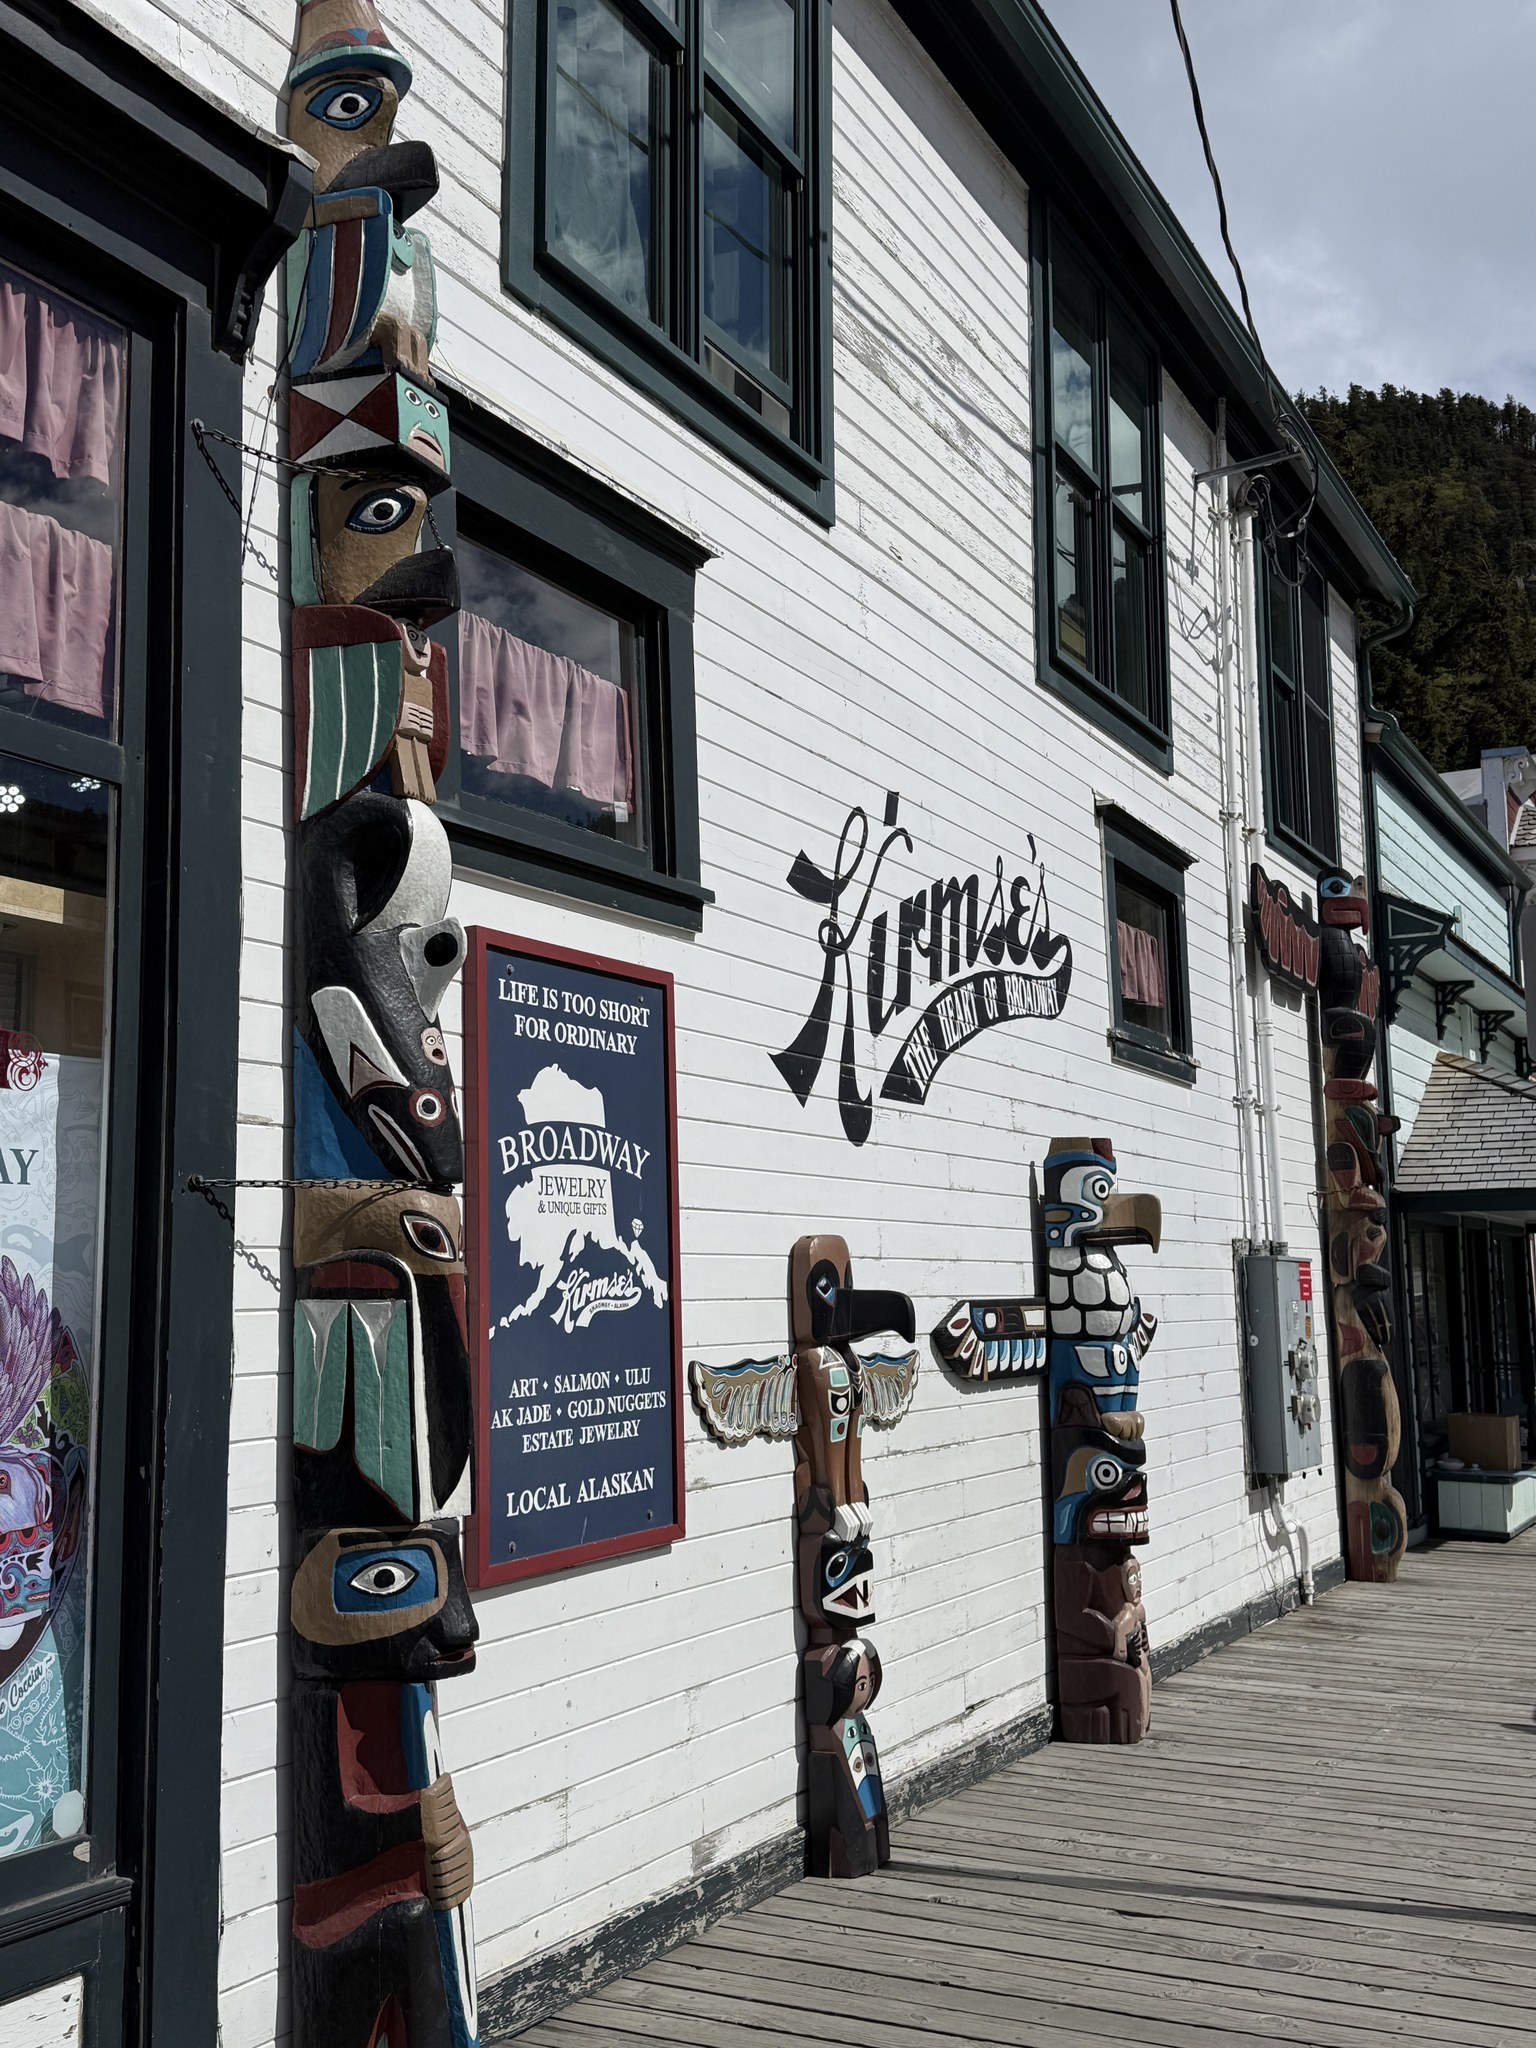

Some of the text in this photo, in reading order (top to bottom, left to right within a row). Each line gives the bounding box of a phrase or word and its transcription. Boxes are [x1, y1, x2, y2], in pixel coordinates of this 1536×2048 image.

[767, 791, 1072, 1147] Kirmse's
[498, 978, 650, 1028] LIFE IS TOO SHORT
[514, 1014, 638, 1055] FOR ORDINARY
[902, 973, 1060, 1098] THE HEART OF BROADWAY
[497, 1125, 651, 1180] BROADWAY
[538, 1174, 607, 1199] JEWELRY
[538, 1200, 607, 1216] & UNIQUE GIFTS
[550, 1267, 642, 1334] Kirmse's
[509, 1367, 651, 1399] ART SALMON ULU
[490, 1391, 666, 1429] AK JADE GOLD NUGGETS
[522, 1419, 640, 1453] ESTATE JEWELRY
[506, 1467, 655, 1517] LOCAL ALASKAN
[10, 1664, 43, 1708] Coccia
